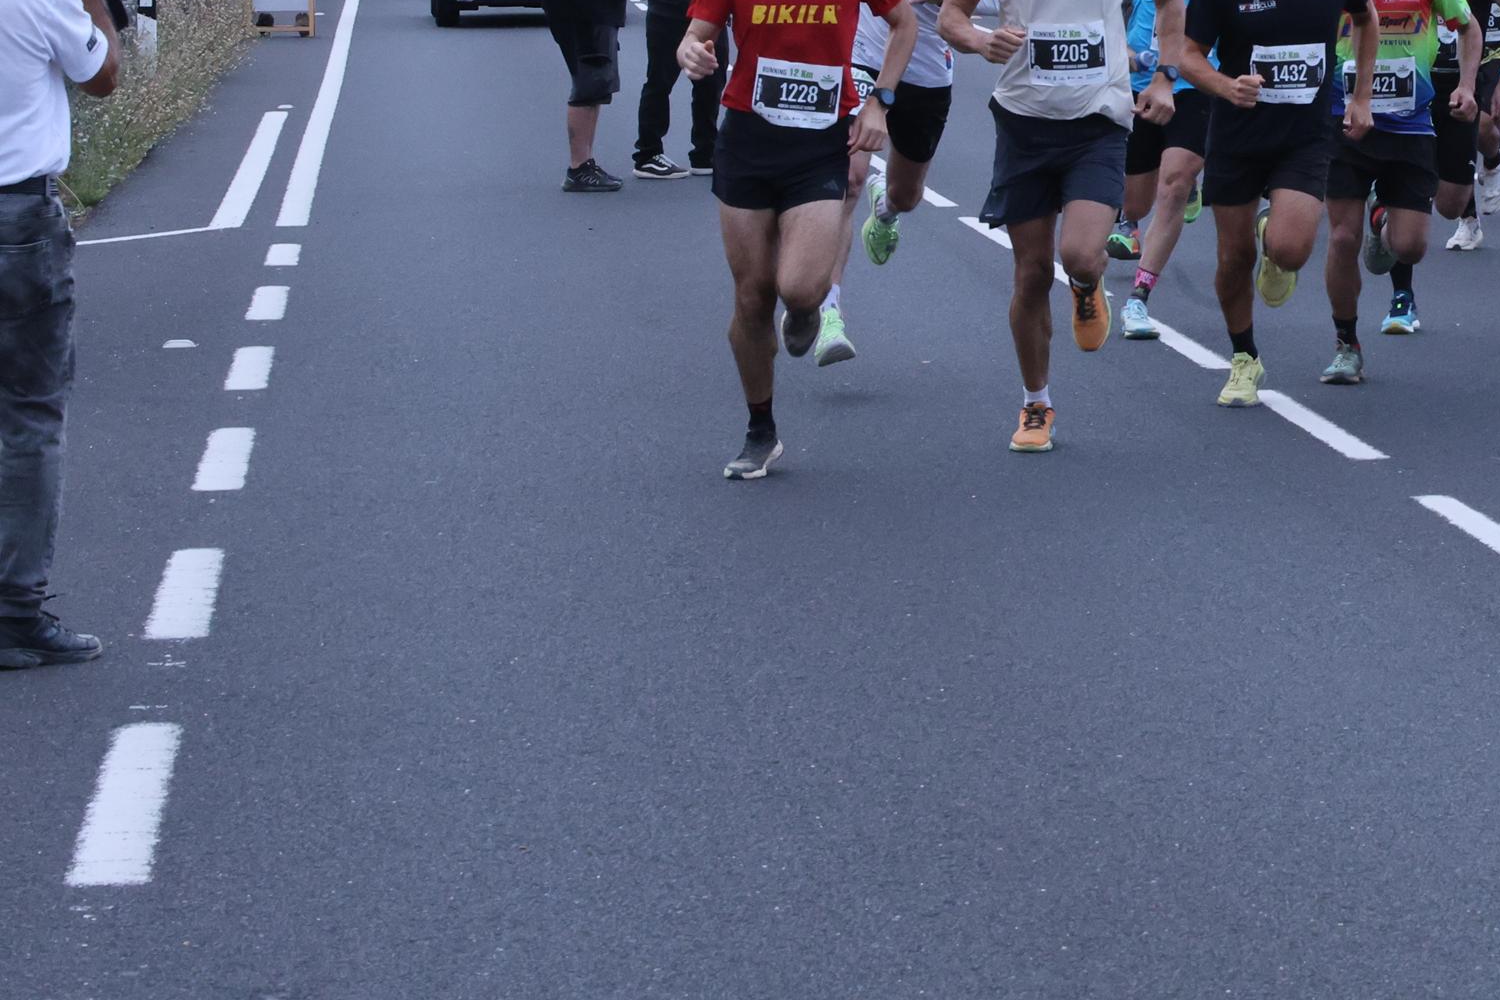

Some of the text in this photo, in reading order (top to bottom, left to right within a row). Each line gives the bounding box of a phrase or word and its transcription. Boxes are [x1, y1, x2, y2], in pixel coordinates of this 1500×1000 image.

[752, 4, 839, 24] BIKILA
[1057, 29, 1067, 38] 12
[1069, 29, 1081, 38] Km
[1051, 43, 1089, 62] 1205
[789, 68, 800, 77] 12
[801, 69, 814, 79] Km
[1271, 63, 1308, 82] 1432
[779, 82, 819, 104] 1228
[1372, 76, 1397, 92] 421
